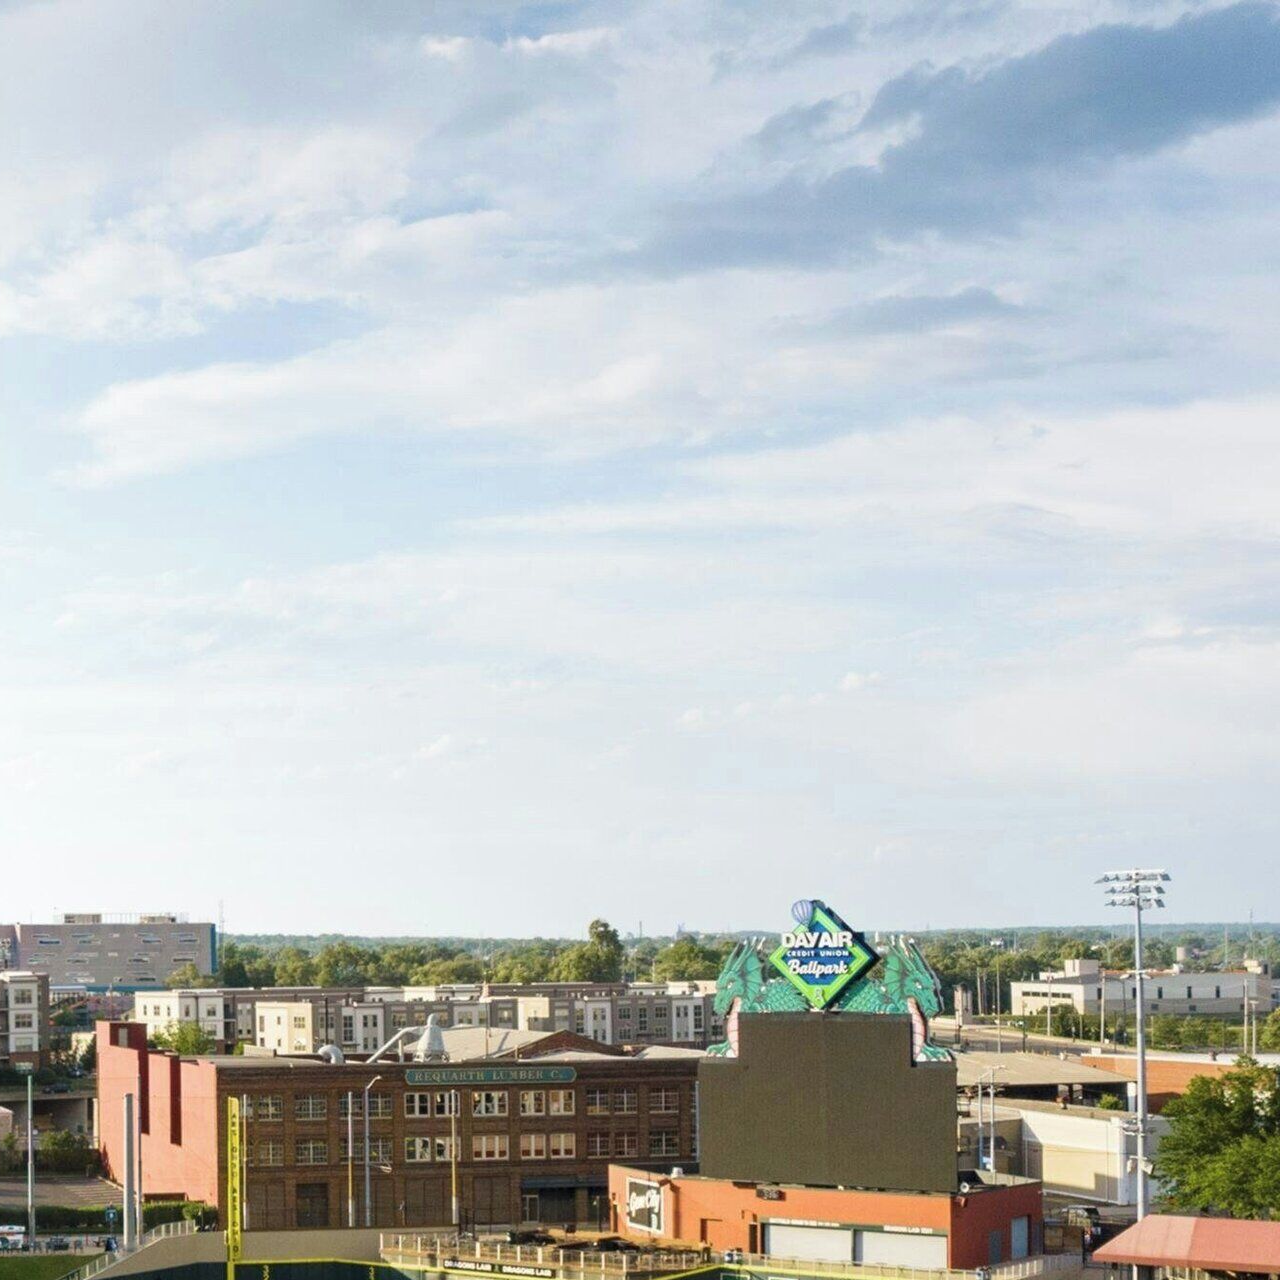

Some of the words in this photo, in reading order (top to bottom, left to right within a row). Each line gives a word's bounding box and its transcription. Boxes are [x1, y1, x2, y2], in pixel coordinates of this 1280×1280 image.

[788, 959, 849, 979] Ballpark
[415, 1071, 484, 1083] REQUARTH
[492, 1069, 544, 1081] LUMBER
[444, 1260, 475, 1270] DRAGONS
[476, 1263, 492, 1271] LAIR
[502, 1265, 535, 1275] DRAGONS
[535, 1269, 552, 1277] LAIR
